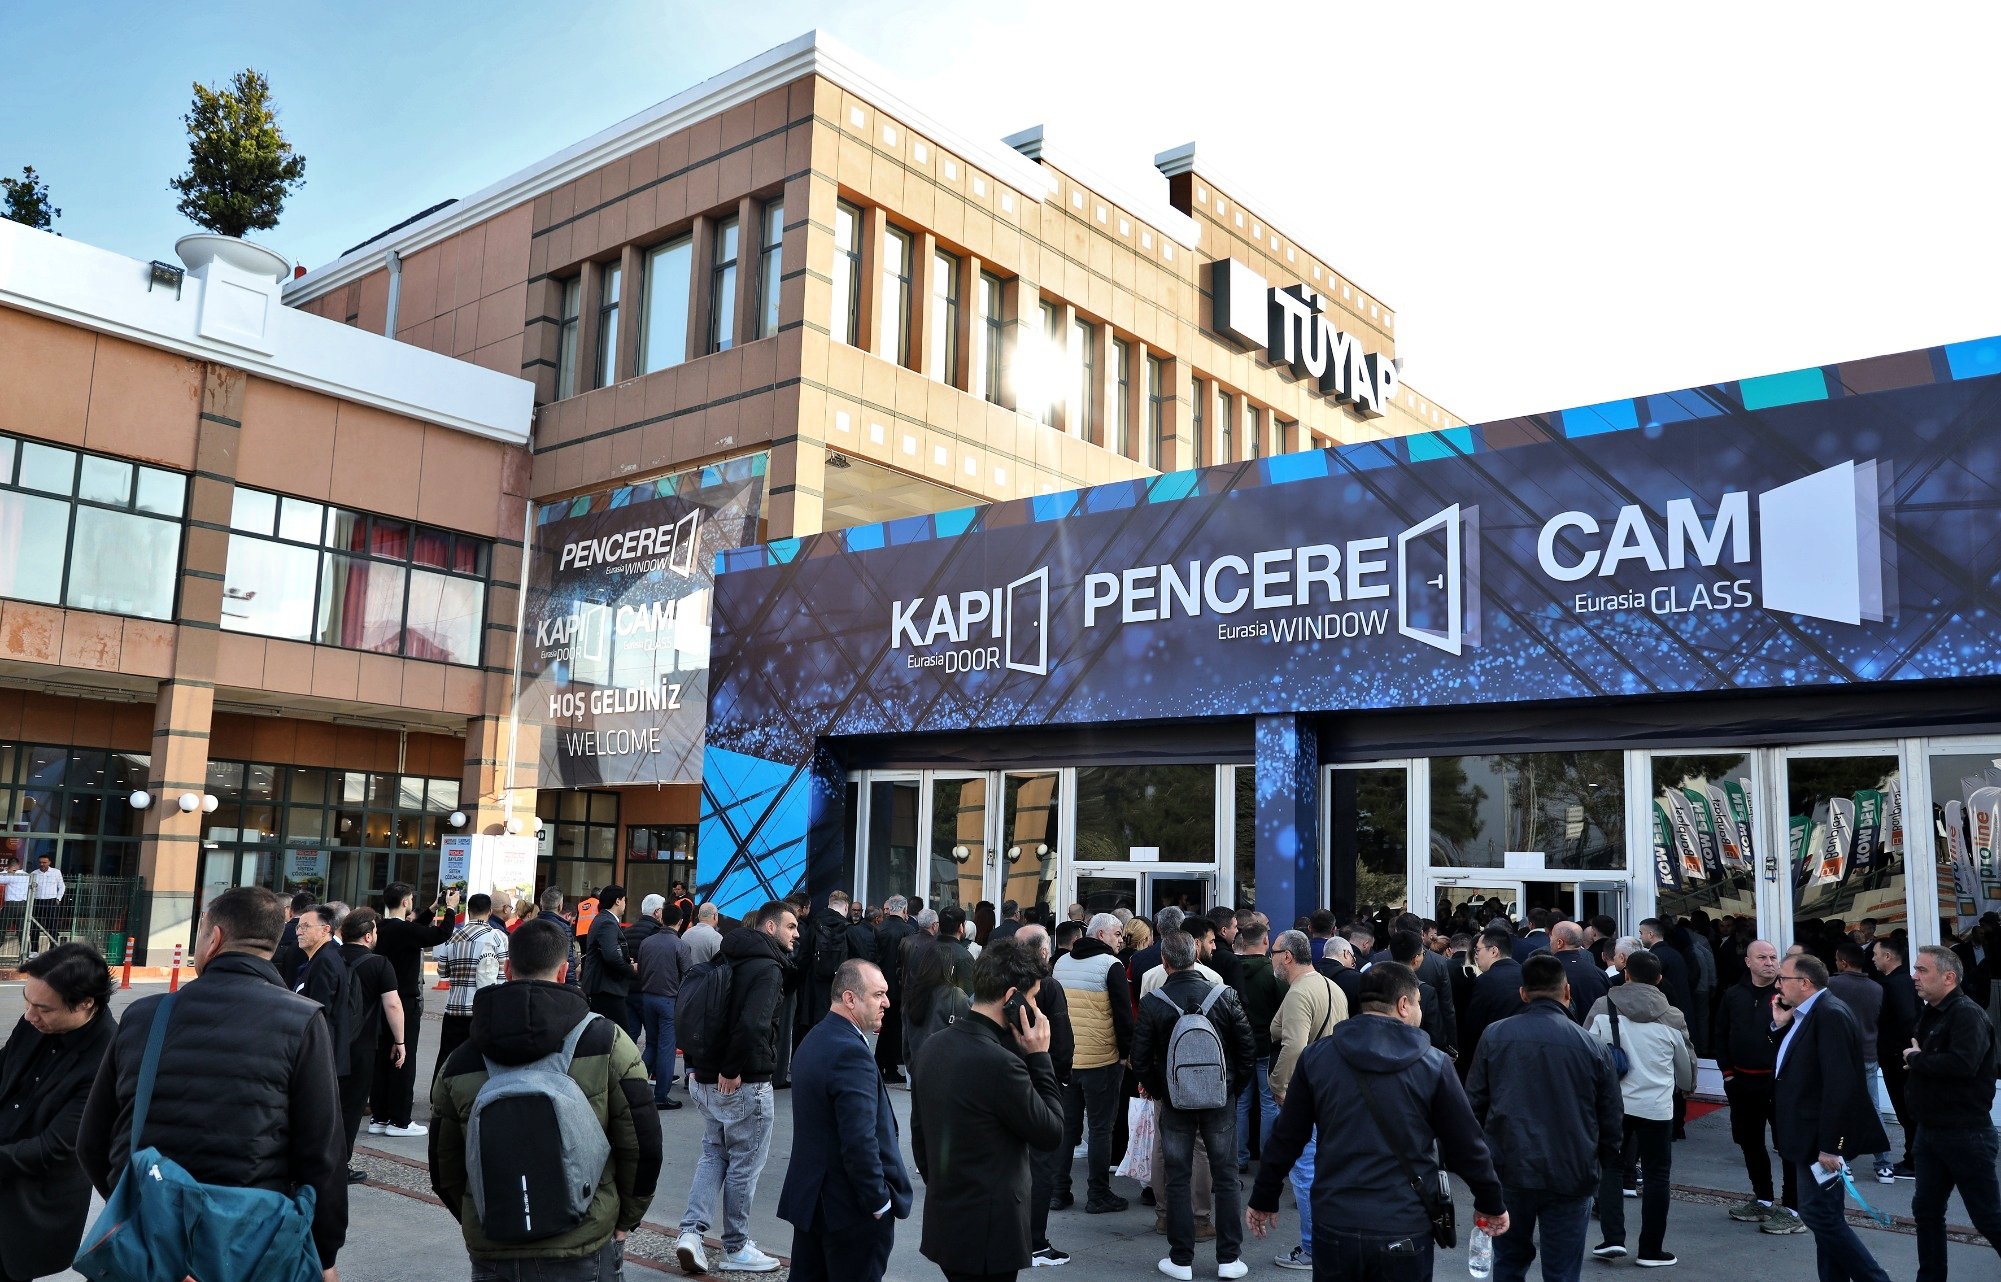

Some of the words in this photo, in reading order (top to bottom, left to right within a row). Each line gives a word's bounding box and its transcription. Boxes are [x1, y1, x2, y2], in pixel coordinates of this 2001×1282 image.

[1269, 284, 1399, 417] TÜYAP
[560, 524, 675, 571] PENCERE
[1537, 491, 1750, 581] CAM
[606, 565, 625, 575] Eurasia
[625, 557, 670, 576] WINDOW
[1084, 536, 1390, 628] PENCERE
[1575, 589, 1645, 613] Eurasia
[1650, 579, 1752, 614] GLASS
[536, 614, 586, 648] KAPI
[615, 599, 676, 636] CAM
[892, 588, 1003, 649] KAPI
[1218, 620, 1268, 640] Eurasia
[1269, 609, 1390, 644] WINDOW
[541, 650, 557, 659] Eurasia
[557, 646, 582, 661] DOOR
[644, 636, 673, 651] GLASS
[908, 652, 943, 668] Eurasia
[945, 647, 1000, 673] DOOR
[550, 691, 586, 722] HOŞ
[590, 677, 681, 715] GELDİNİZ
[566, 728, 661, 756] WELCOME
[1974, 811, 1996, 878] proline
